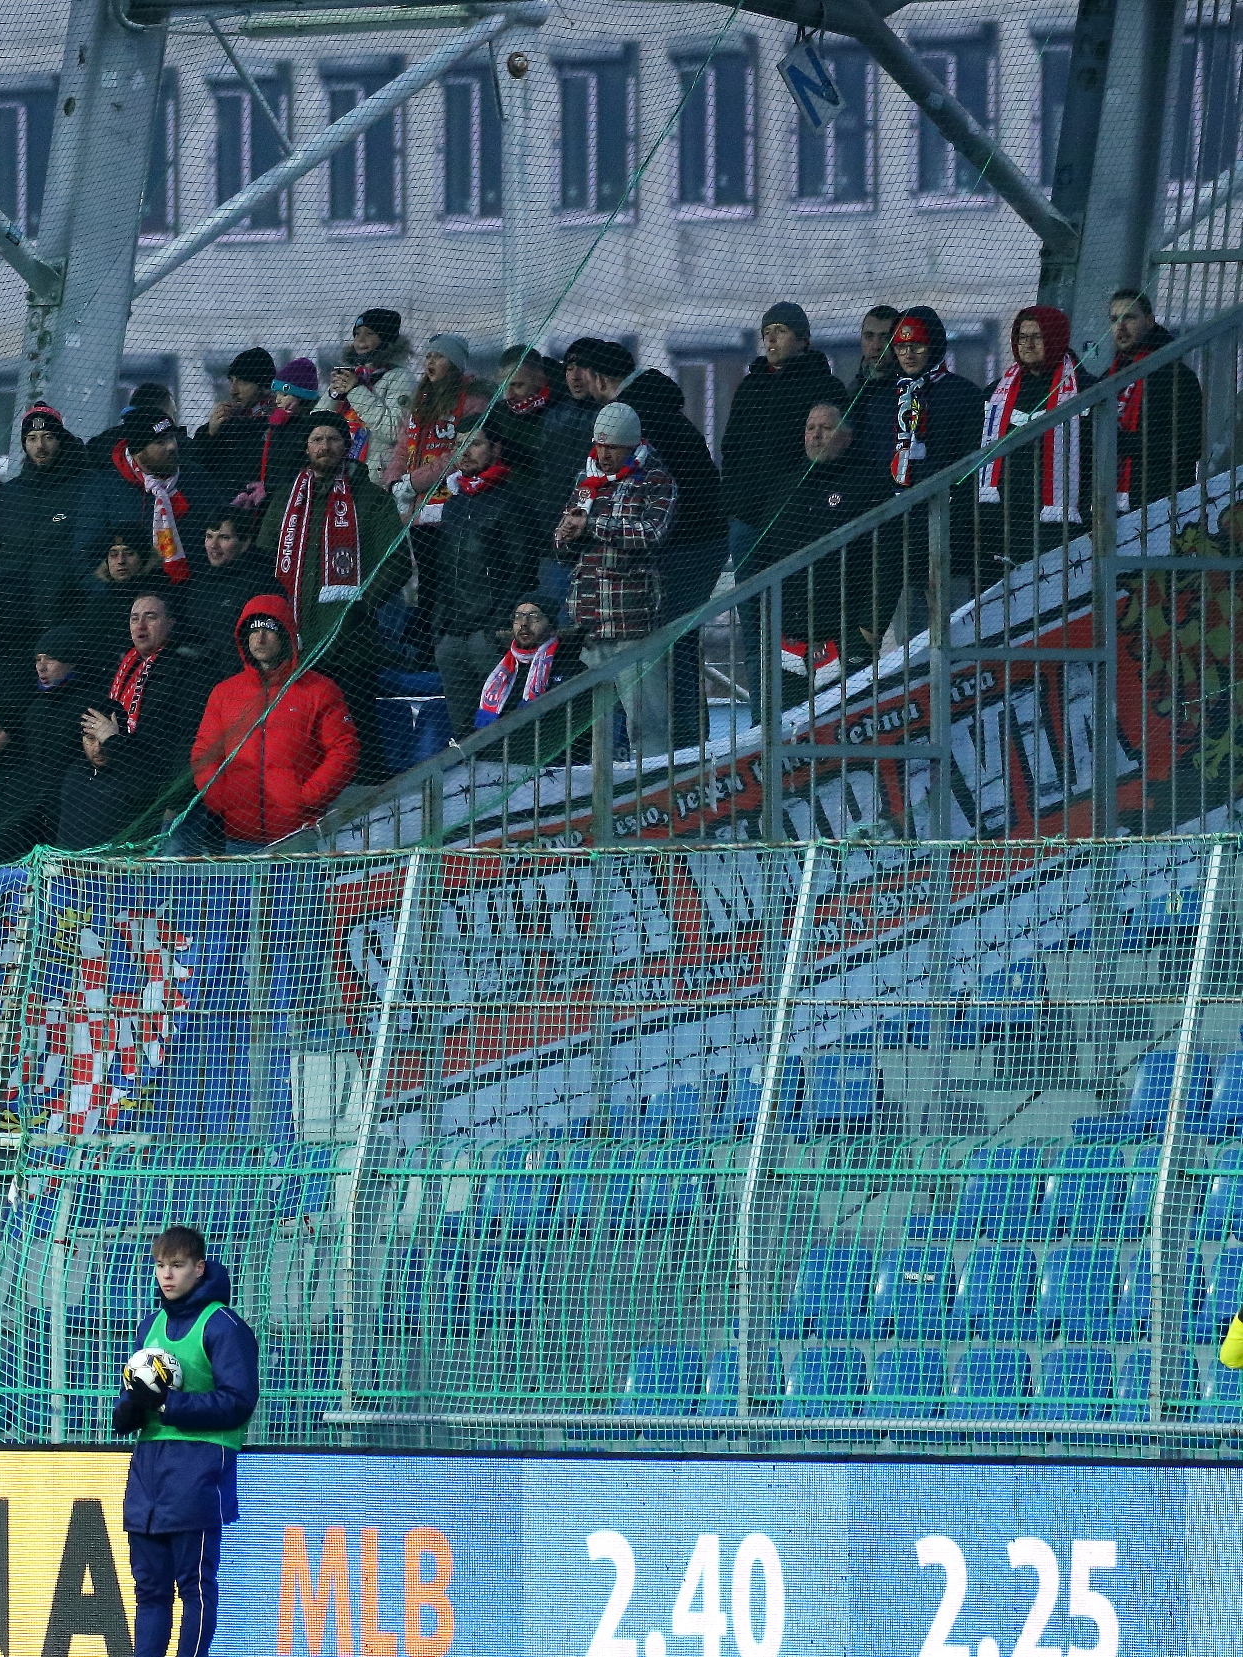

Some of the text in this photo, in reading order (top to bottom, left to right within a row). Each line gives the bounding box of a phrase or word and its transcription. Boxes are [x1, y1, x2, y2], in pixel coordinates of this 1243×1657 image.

[786, 47, 840, 128] N
[277, 1526, 455, 1657] MLB
[585, 1528, 787, 1657] 2.40
[914, 1534, 1121, 1657] 2.25
